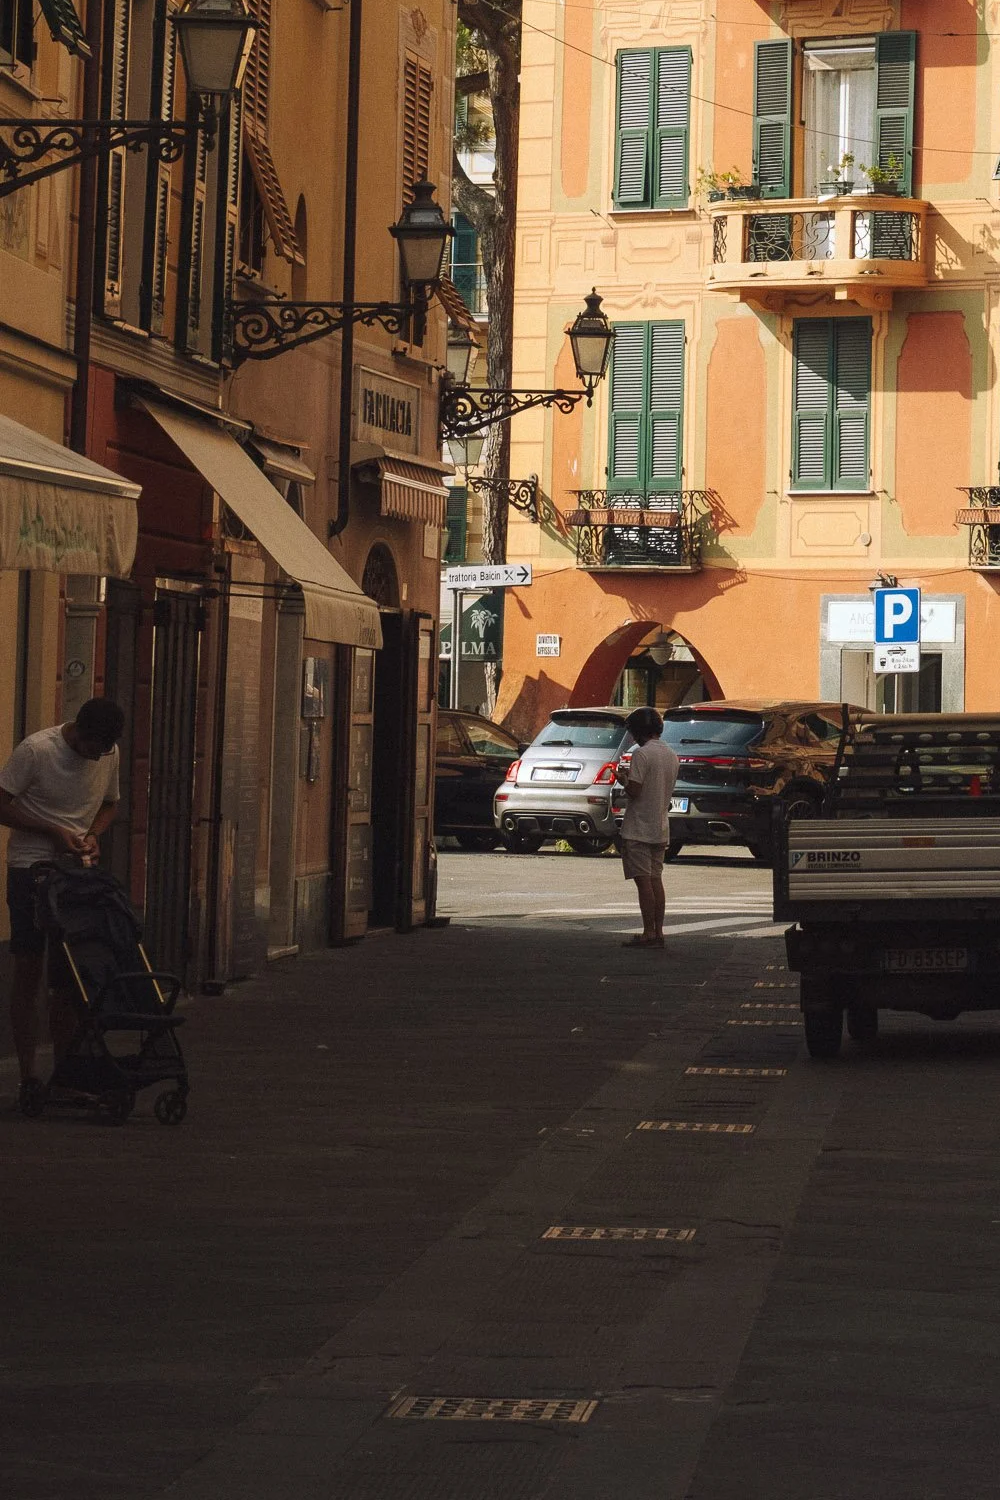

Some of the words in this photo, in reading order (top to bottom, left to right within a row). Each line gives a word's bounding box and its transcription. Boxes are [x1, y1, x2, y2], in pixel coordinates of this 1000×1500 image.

[363, 388, 411, 436] FARMACIA
[449, 573, 477, 583] trattoria
[480, 571, 501, 581] Baicin
[883, 593, 913, 639] P
[441, 641, 496, 655] PLMA
[807, 851, 861, 862] BRINZO
